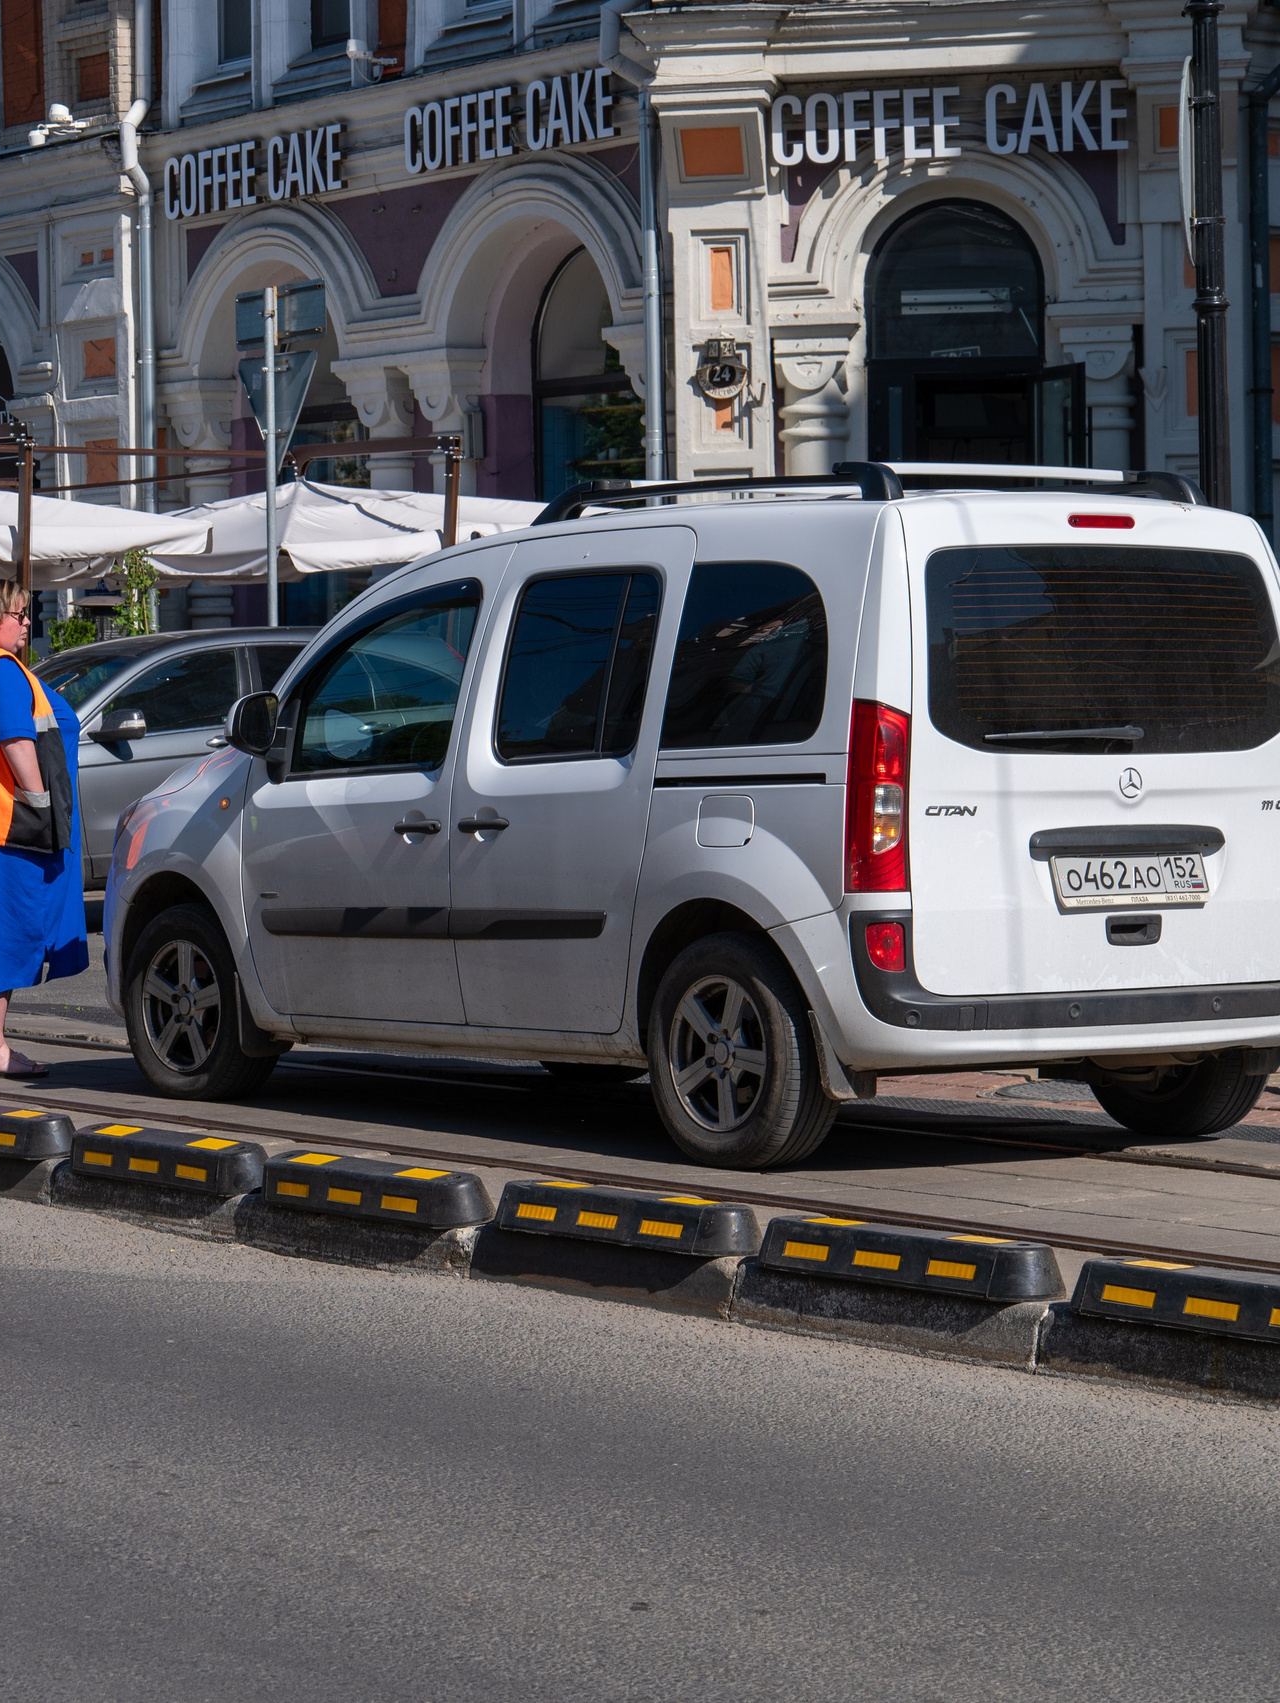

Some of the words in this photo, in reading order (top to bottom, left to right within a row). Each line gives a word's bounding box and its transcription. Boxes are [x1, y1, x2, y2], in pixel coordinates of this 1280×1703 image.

[404, 86, 514, 174] COFFEE
[526, 67, 615, 151] CAKE
[771, 86, 962, 166] COFFEE
[984, 79, 1130, 155] CAKE
[164, 140, 257, 220] COFFEE
[267, 123, 342, 201] CAKE
[723, 342, 732, 355] 24
[713, 365, 731, 382] 24
[925, 805, 978, 816] CITAN
[1163, 856, 1199, 879] 152
[1174, 879, 1192, 889] RUS
[1076, 897, 1115, 906] Mercedes-Benz
